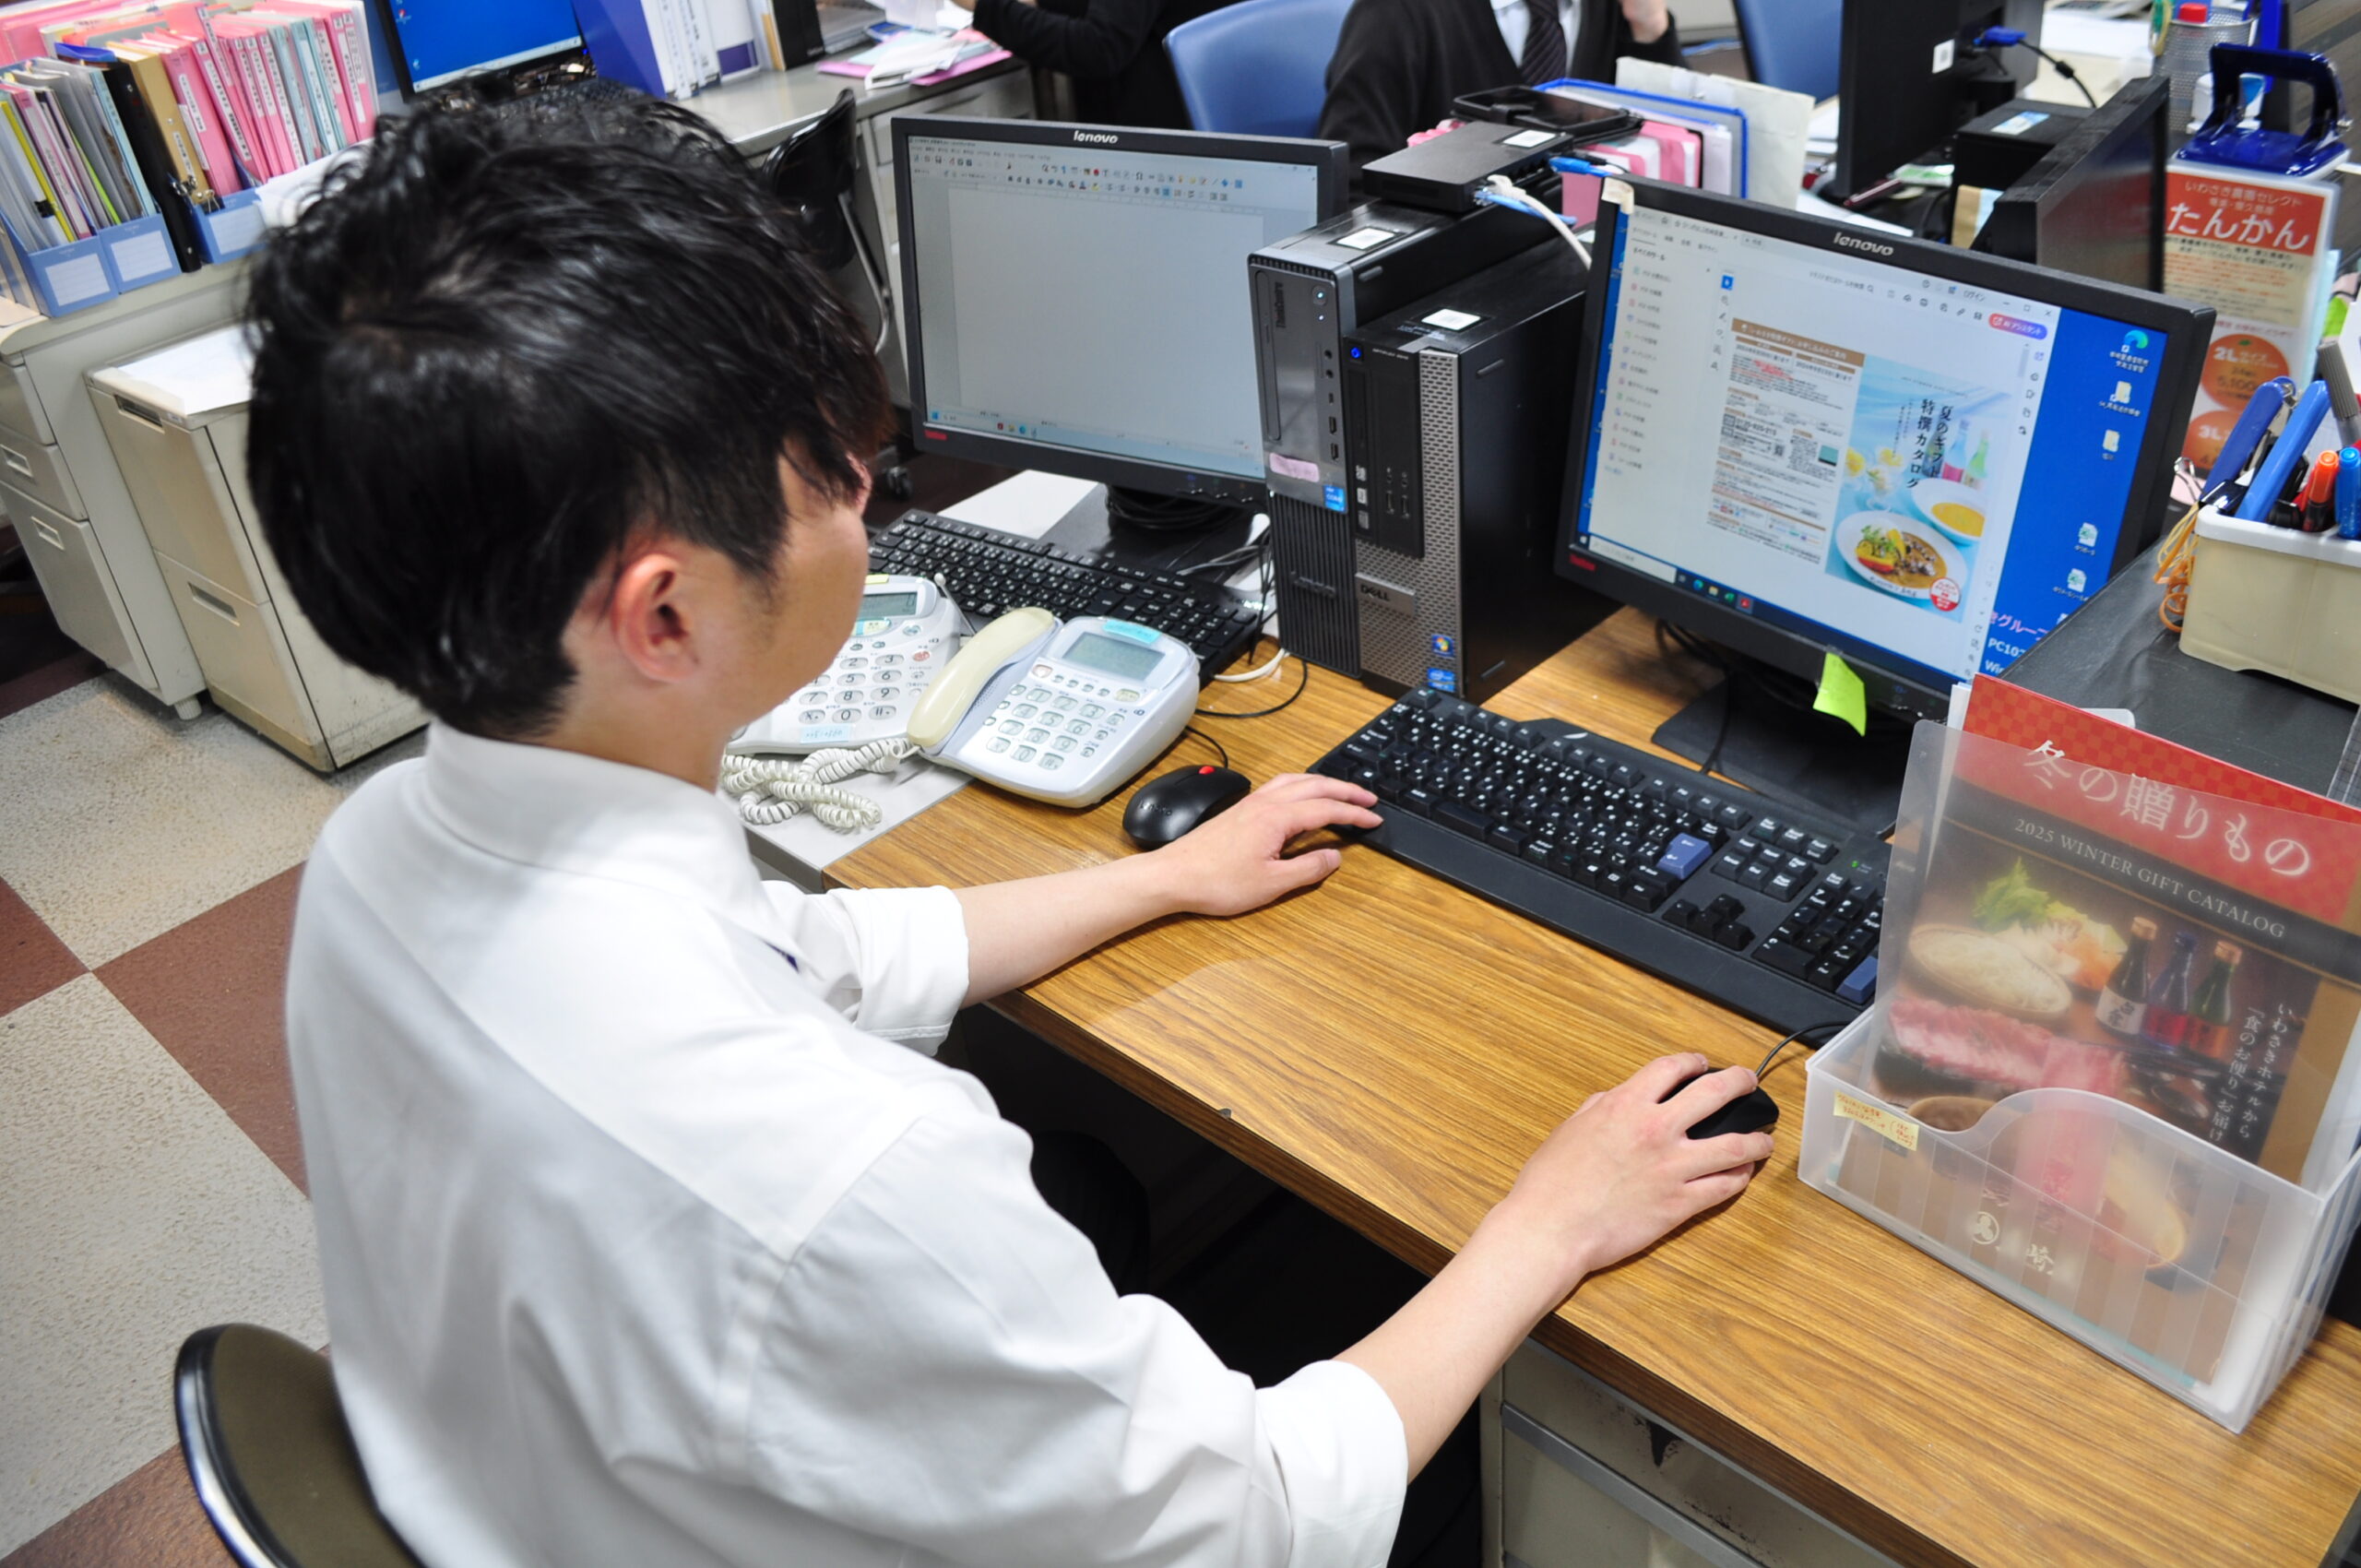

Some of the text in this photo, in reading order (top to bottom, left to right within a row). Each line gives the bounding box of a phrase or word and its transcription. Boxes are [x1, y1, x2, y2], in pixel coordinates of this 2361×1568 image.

[1074, 130, 1119, 144] lenovo
[1833, 232, 1894, 256] lenovo
[2167, 202, 2308, 249] たんかん
[2213, 347, 2238, 362] 2L
[1906, 398, 1936, 489] 特撰カタログ
[1929, 404, 1954, 480] 夏のギフト
[2198, 425, 2222, 440] 3L
[1360, 584, 1391, 601] DELL
[2023, 740, 2310, 876] 冬の贈りもの
[2015, 818, 2287, 939] 2025 WINTER GIFT CATALOG
[2238, 1003, 2293, 1139] いわさきホテルから
